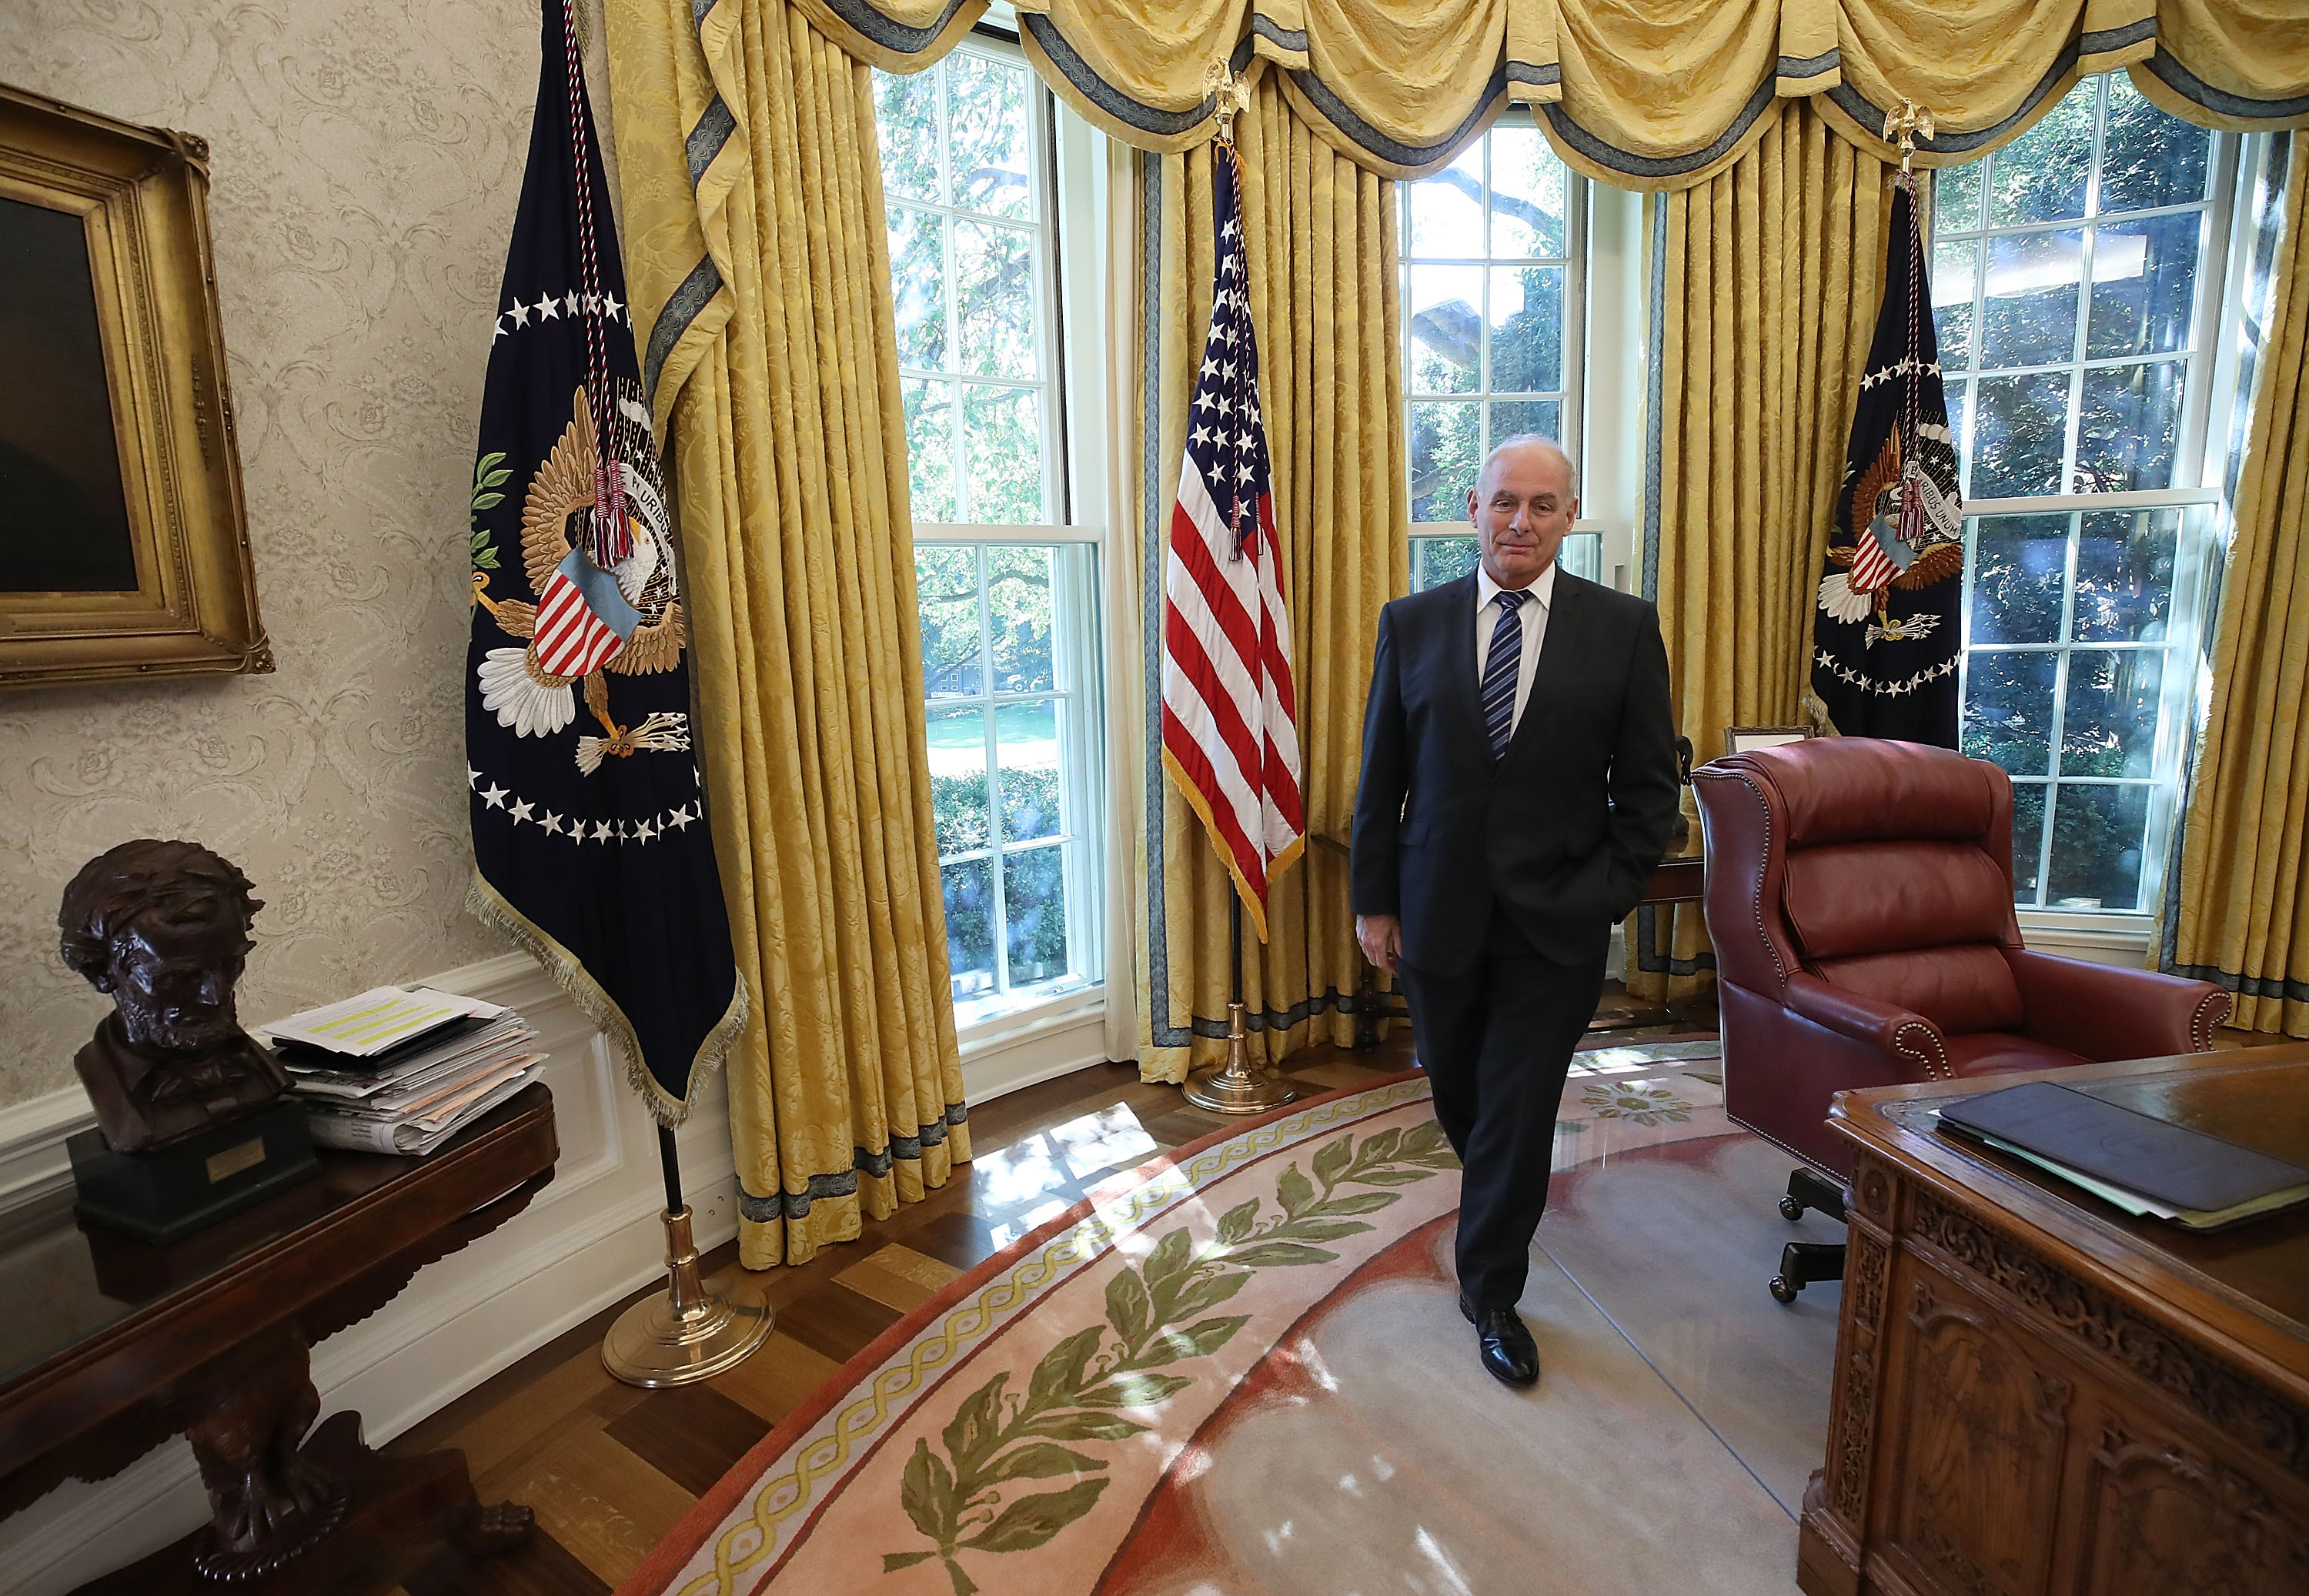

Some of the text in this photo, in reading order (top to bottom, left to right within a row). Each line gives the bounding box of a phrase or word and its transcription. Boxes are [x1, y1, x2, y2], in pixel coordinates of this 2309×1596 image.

[632, 476, 667, 533] PURIBU
[1920, 479, 1940, 509] RIBUS
[1935, 509, 1958, 535] UNUM
